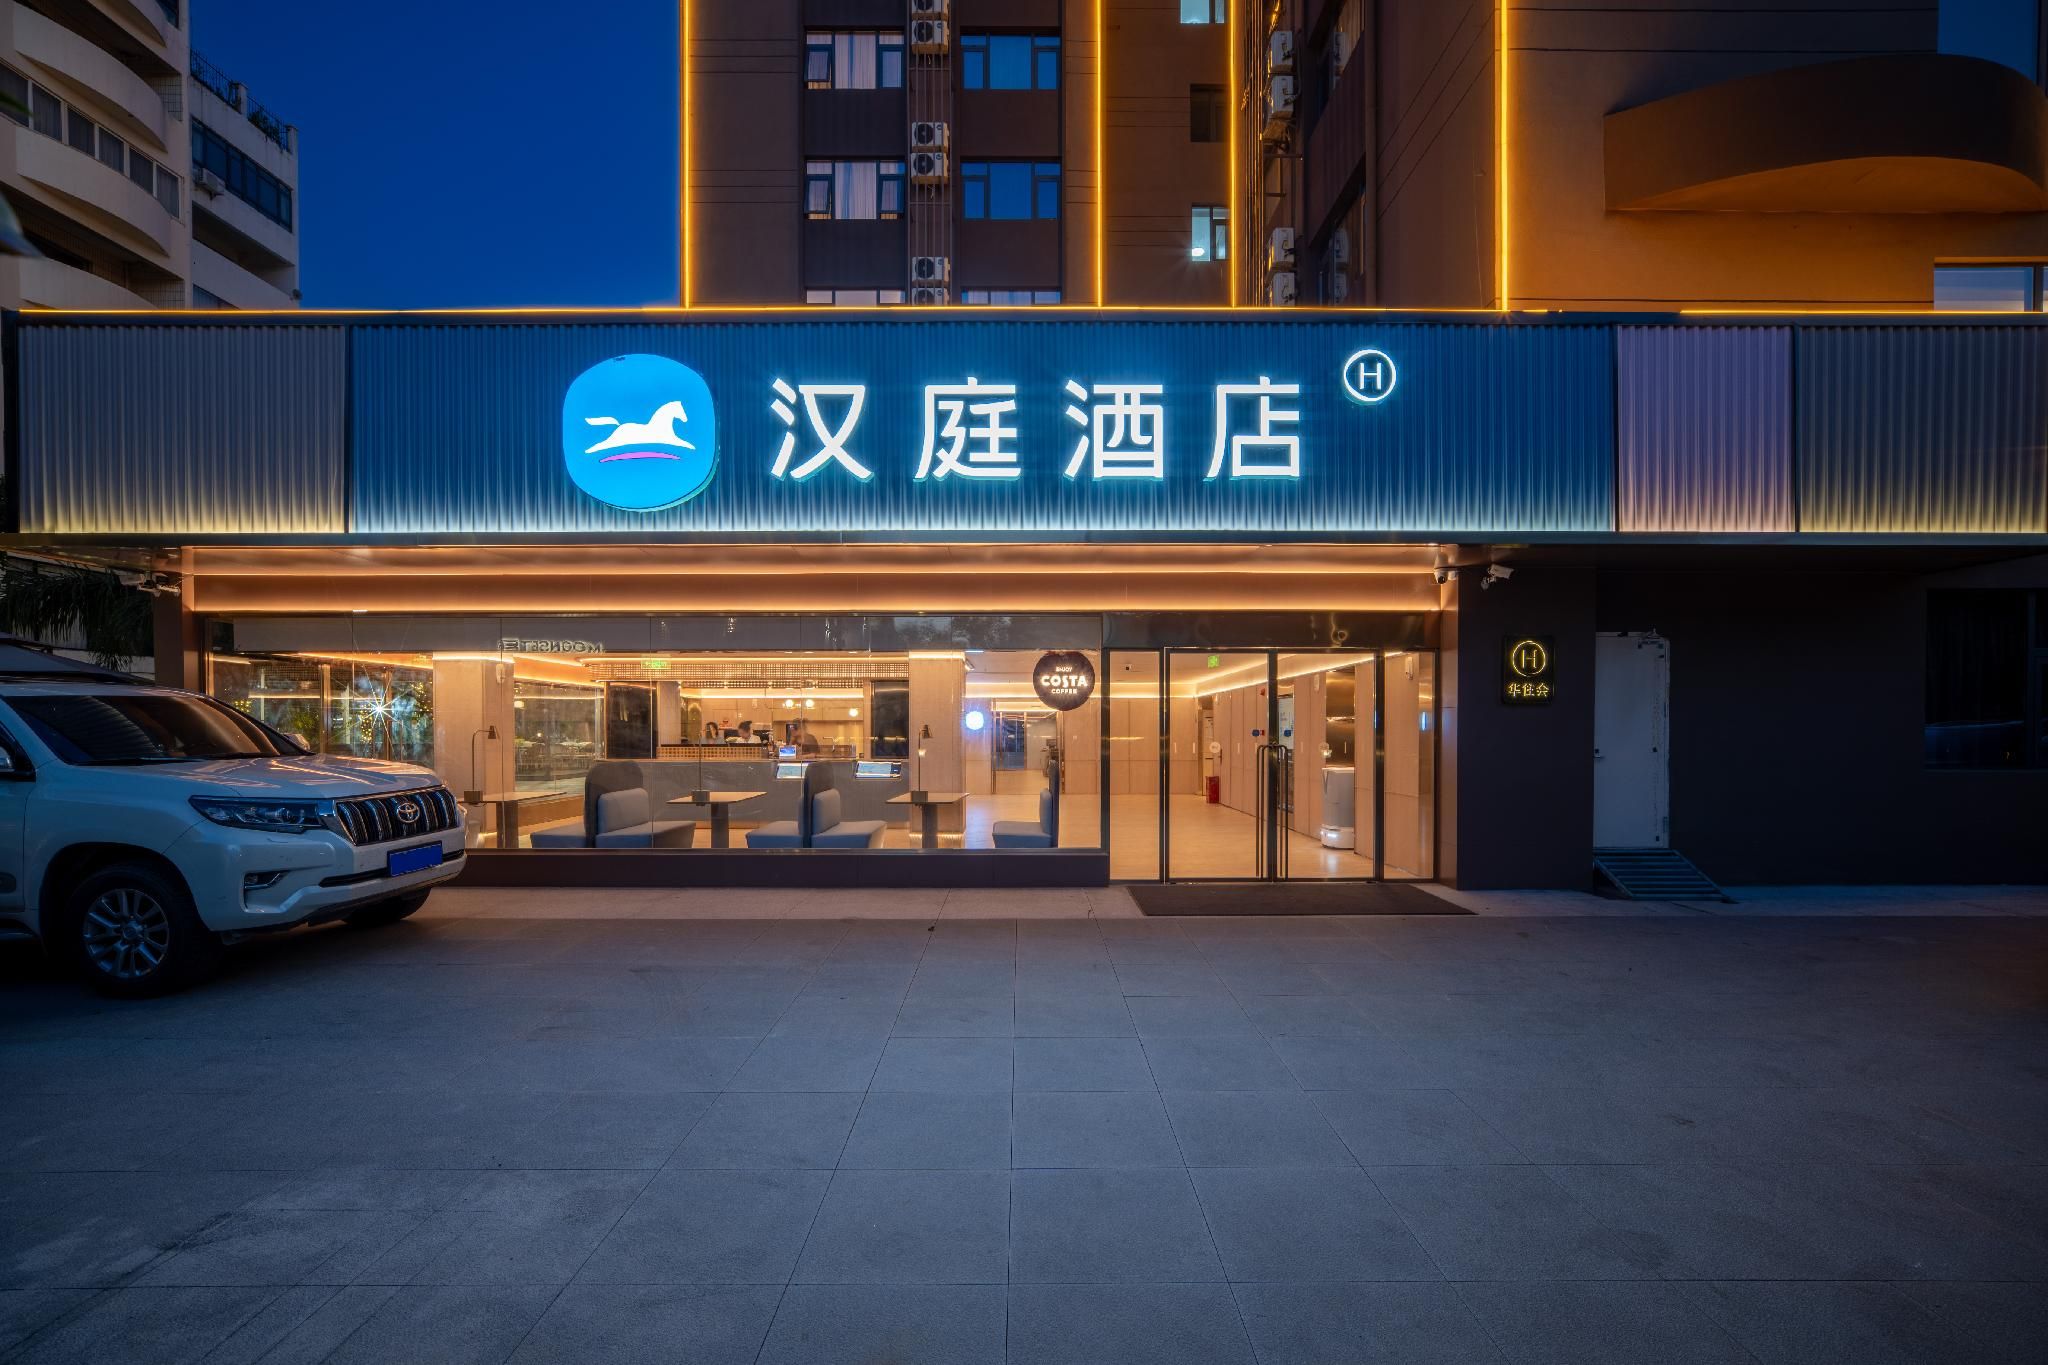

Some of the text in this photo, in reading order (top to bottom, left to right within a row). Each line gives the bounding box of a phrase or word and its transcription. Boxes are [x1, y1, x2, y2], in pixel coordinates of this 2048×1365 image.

[1360, 362, 1382, 390] H
[770, 376, 1301, 480] 汉庭酒店
[1041, 675, 1088, 688] COSTA
[1508, 683, 1549, 697] 华住会
